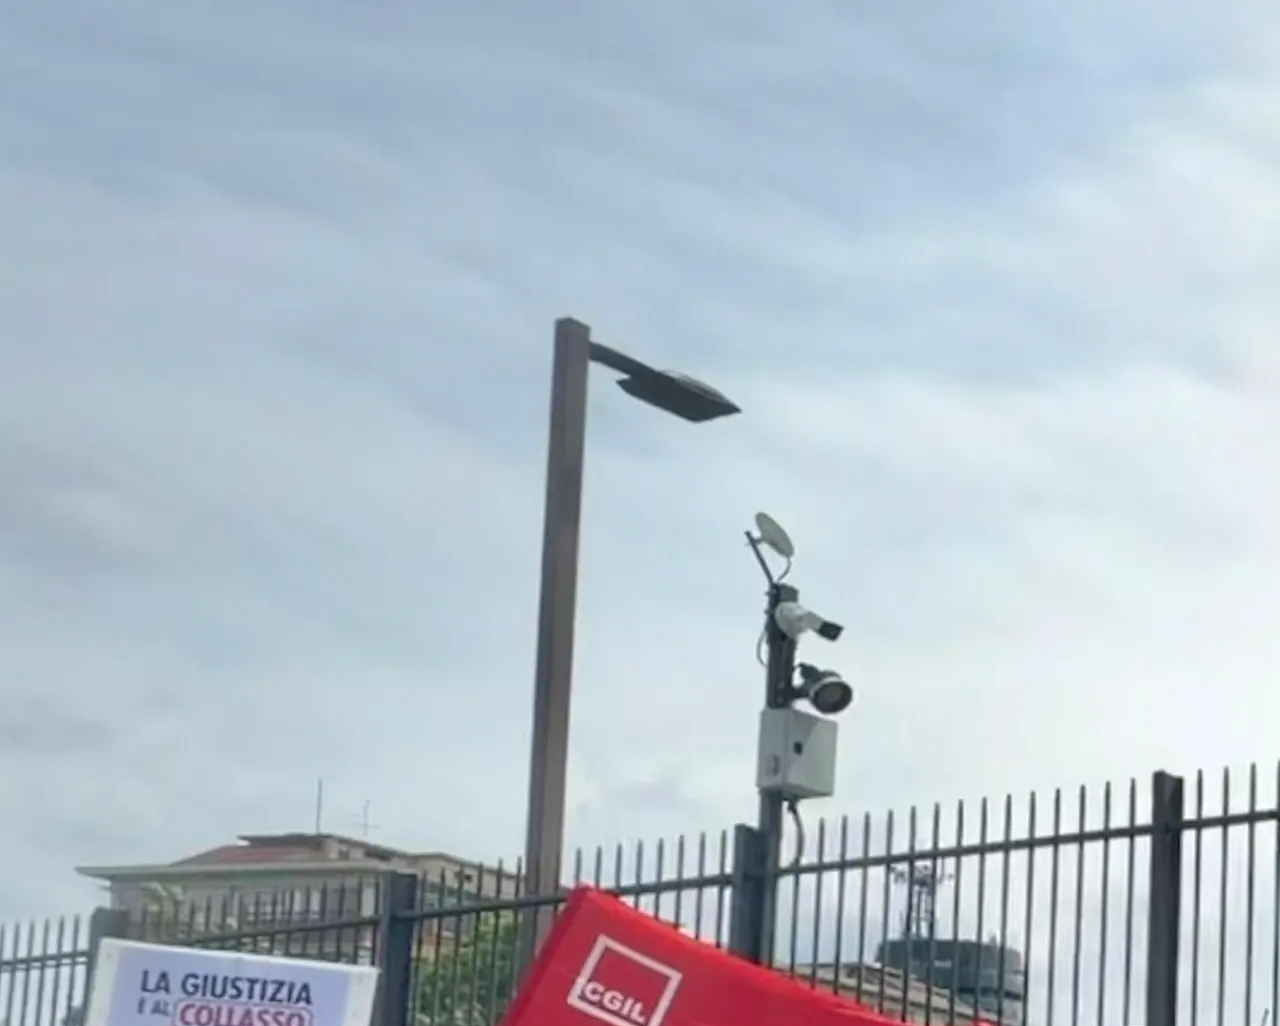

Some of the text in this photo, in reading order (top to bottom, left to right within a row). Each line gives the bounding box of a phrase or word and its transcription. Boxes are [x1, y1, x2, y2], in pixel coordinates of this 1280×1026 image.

[140, 969, 313, 1005] LA GIUSTIZIA
[583, 981, 646, 1024] CGIL
